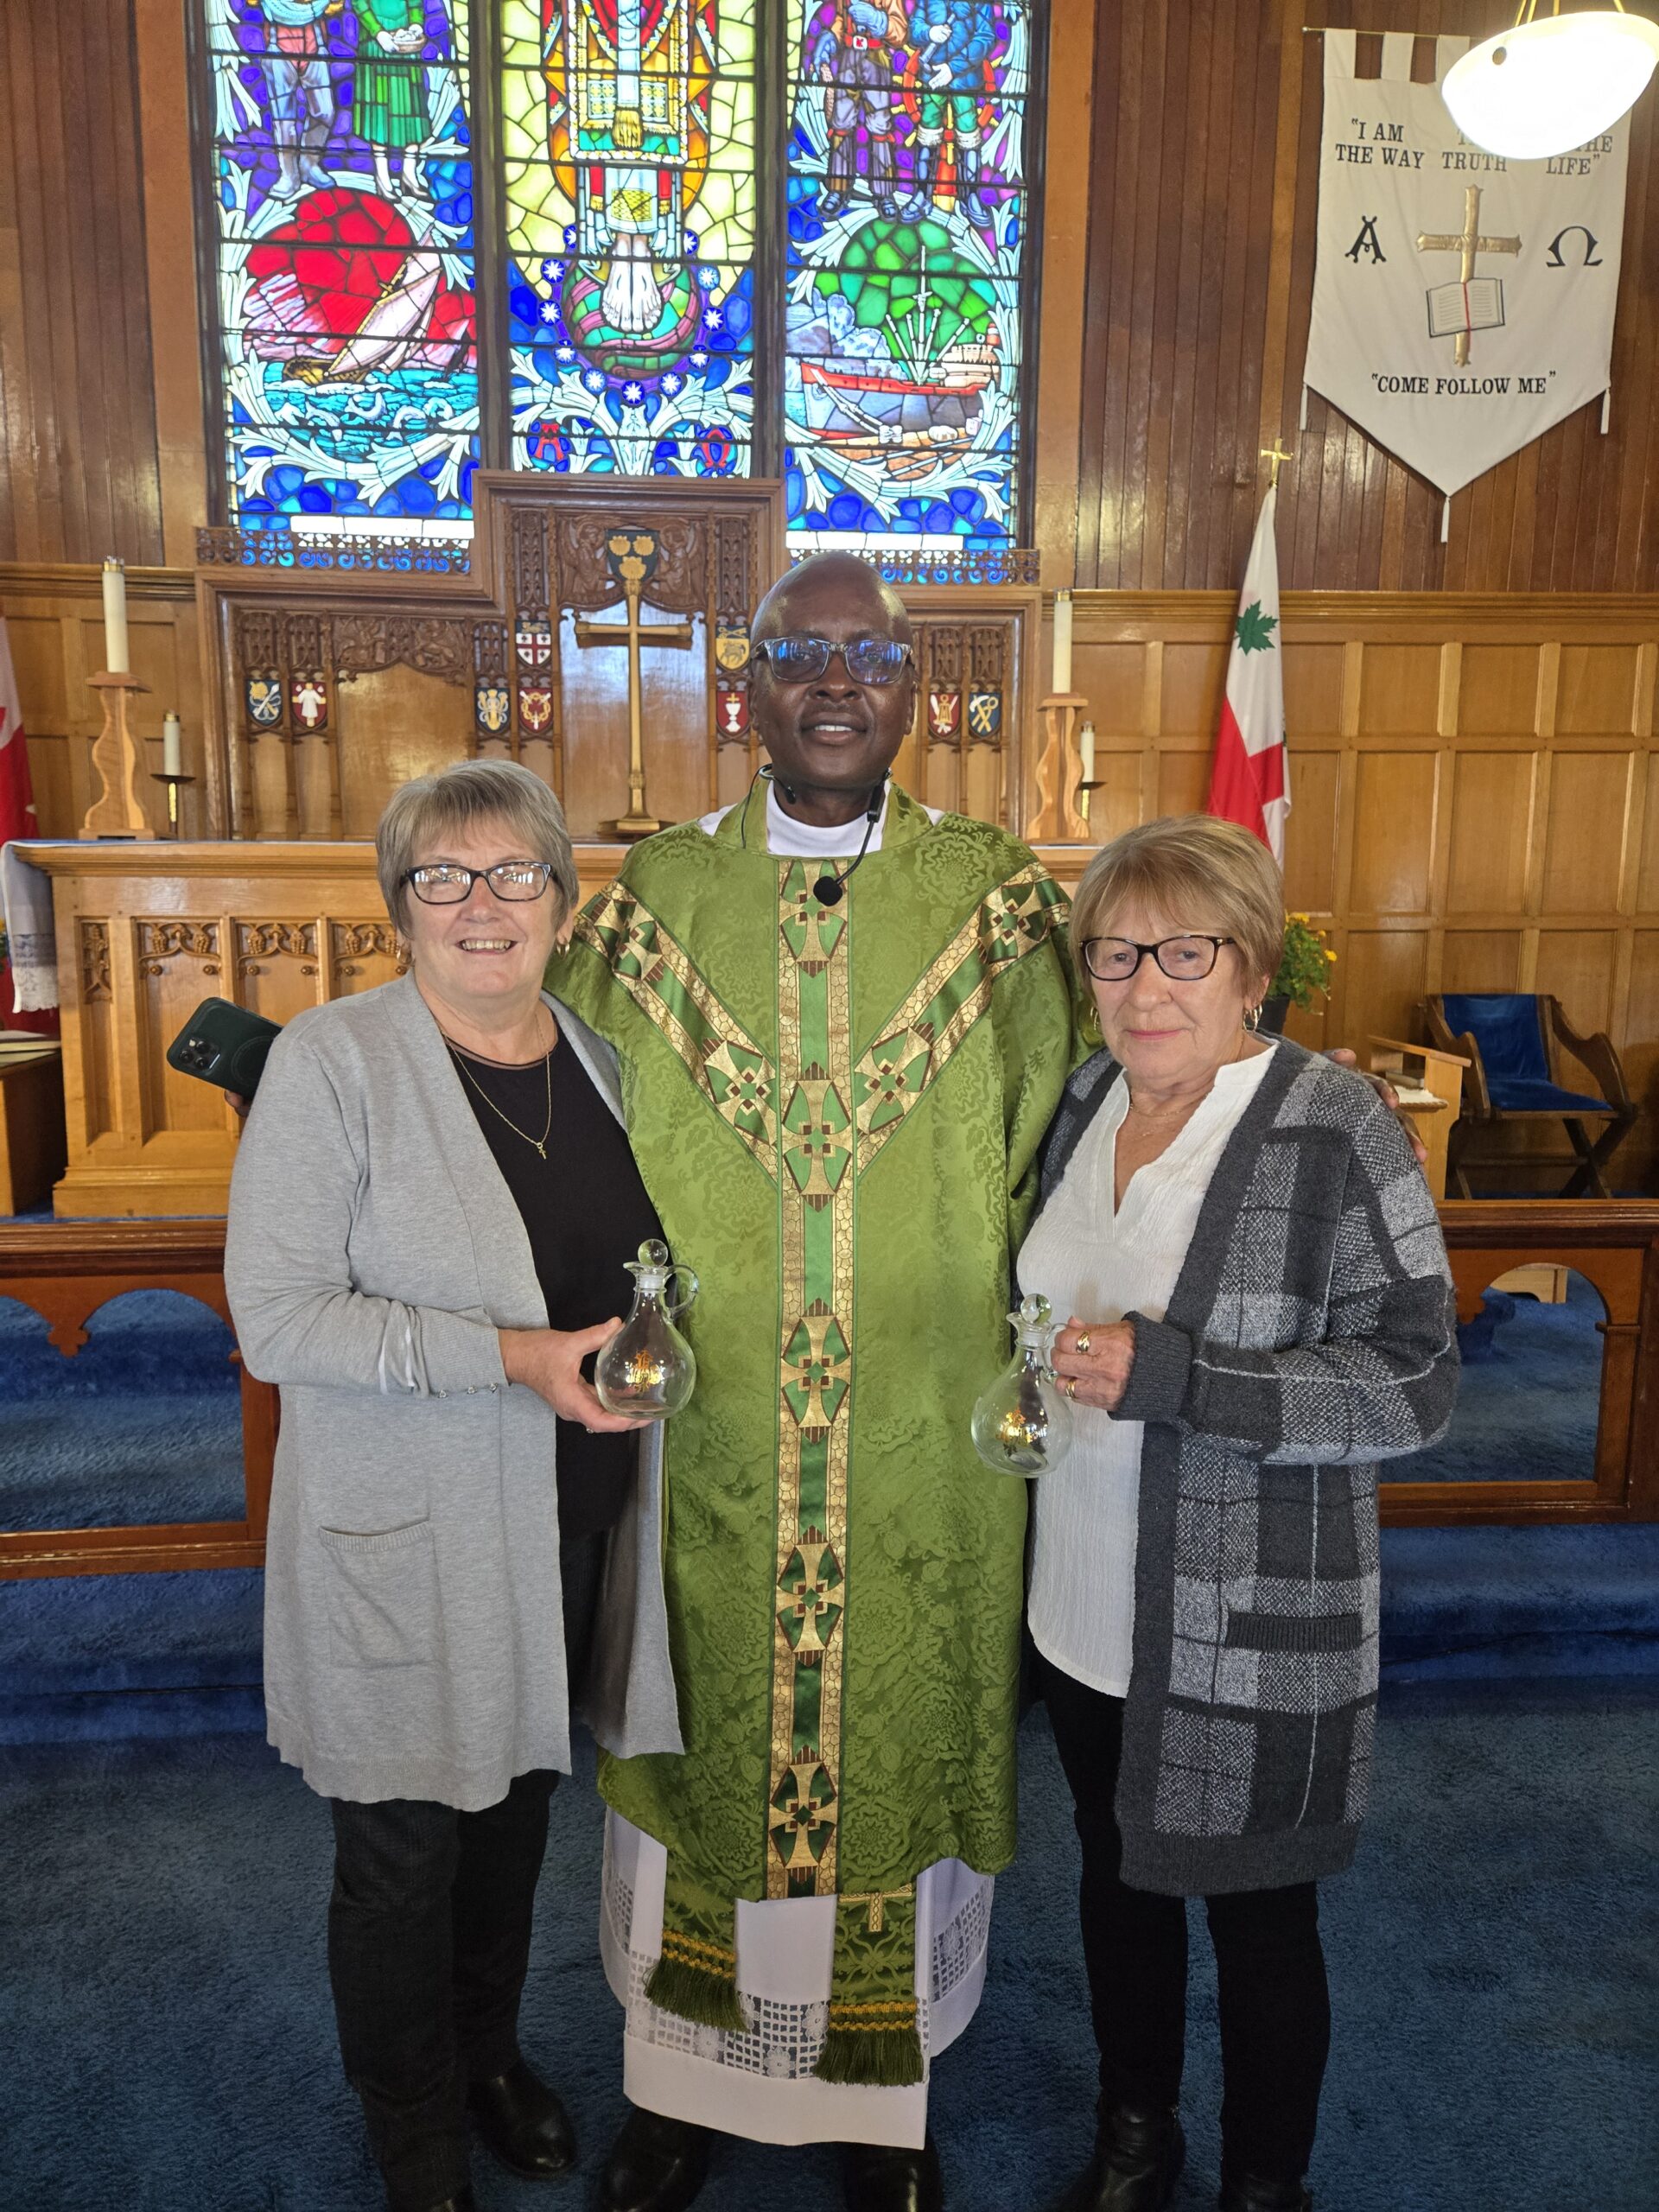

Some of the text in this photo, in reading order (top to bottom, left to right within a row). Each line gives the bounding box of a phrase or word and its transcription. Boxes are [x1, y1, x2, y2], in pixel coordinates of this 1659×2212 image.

[1373, 123, 1404, 143] AM
[1576, 135, 1613, 153] HE
[1336, 143, 1425, 168] THE WAY
[1442, 151, 1507, 172] TRUTH
[1546, 226, 1603, 268] Ω
[1435, 378, 1510, 395] FOLLOW
